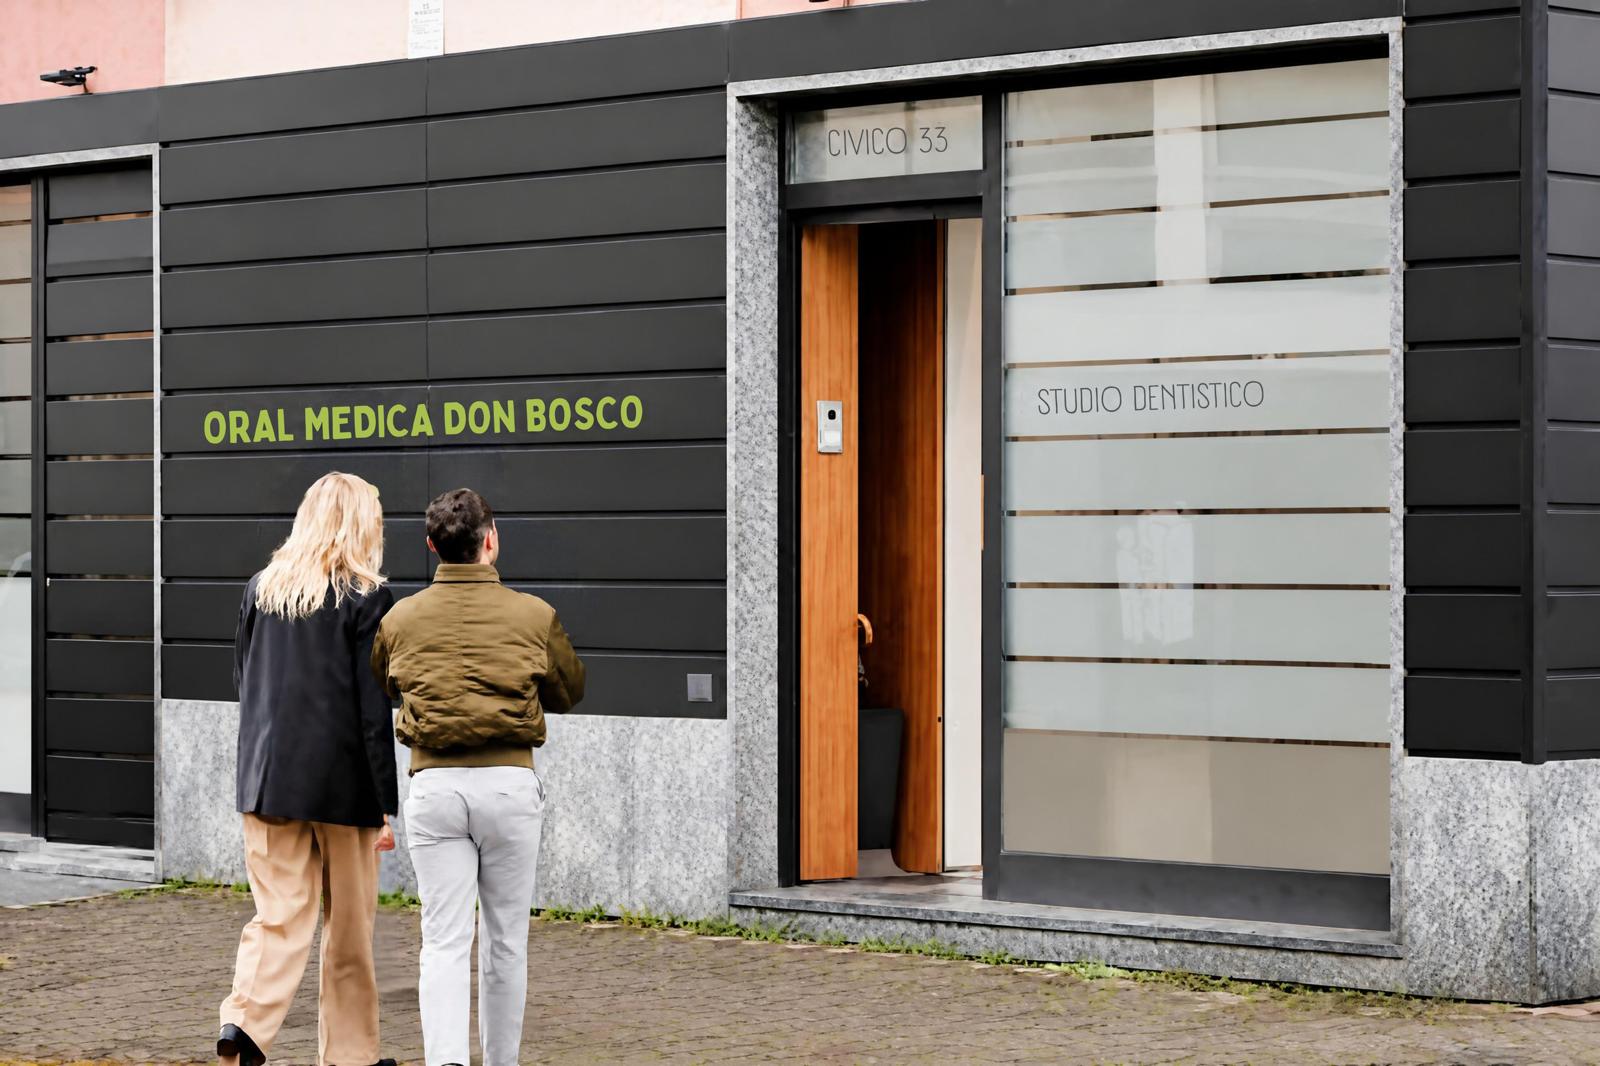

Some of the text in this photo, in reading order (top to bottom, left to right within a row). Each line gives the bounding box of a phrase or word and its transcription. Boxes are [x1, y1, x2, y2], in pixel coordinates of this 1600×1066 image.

[828, 126, 948, 156] CIVICO 33
[1037, 380, 1264, 415] STUDIO DENTISTICO
[203, 395, 643, 444] ORAL MEDICA DON BOSCO
